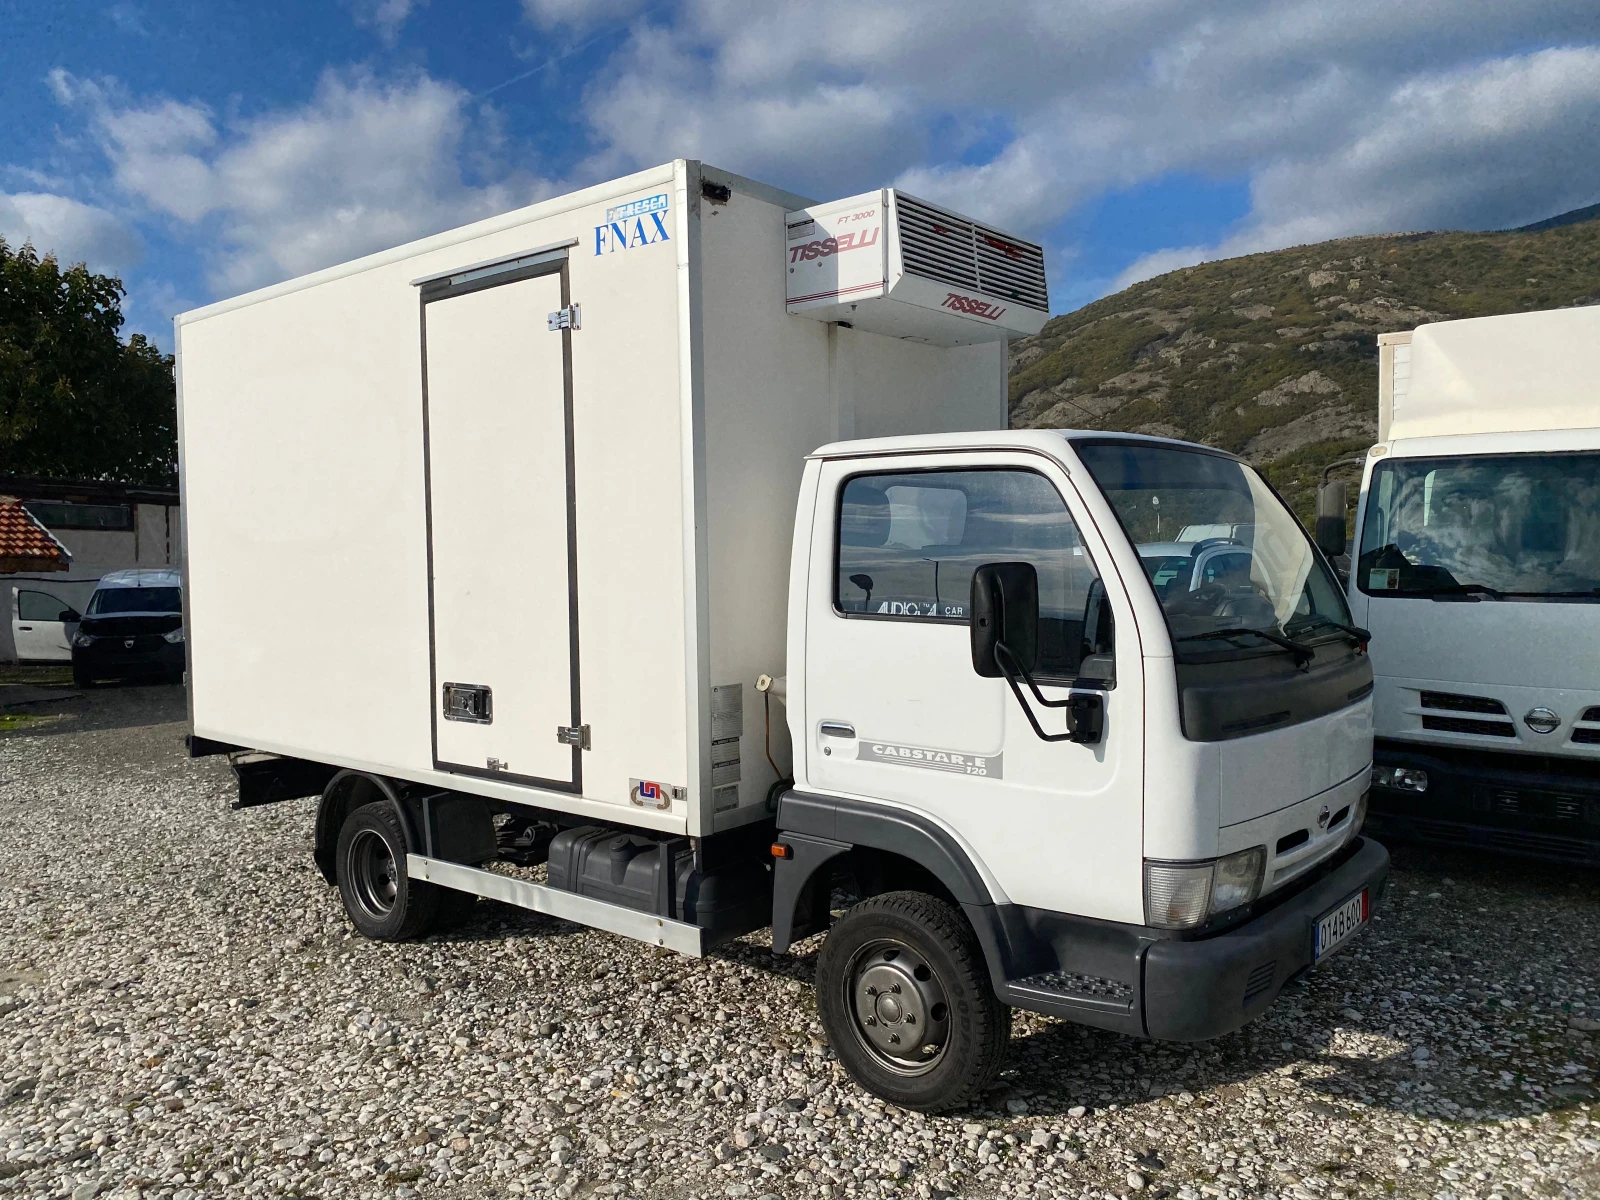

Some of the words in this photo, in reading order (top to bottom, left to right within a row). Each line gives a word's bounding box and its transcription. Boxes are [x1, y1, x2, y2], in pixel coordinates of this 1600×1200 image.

[837, 215, 850, 224] FT
[852, 209, 875, 221] 3000
[593, 208, 671, 257] FNAX
[944, 606, 963, 615] CAR
[966, 766, 987, 776] 120
